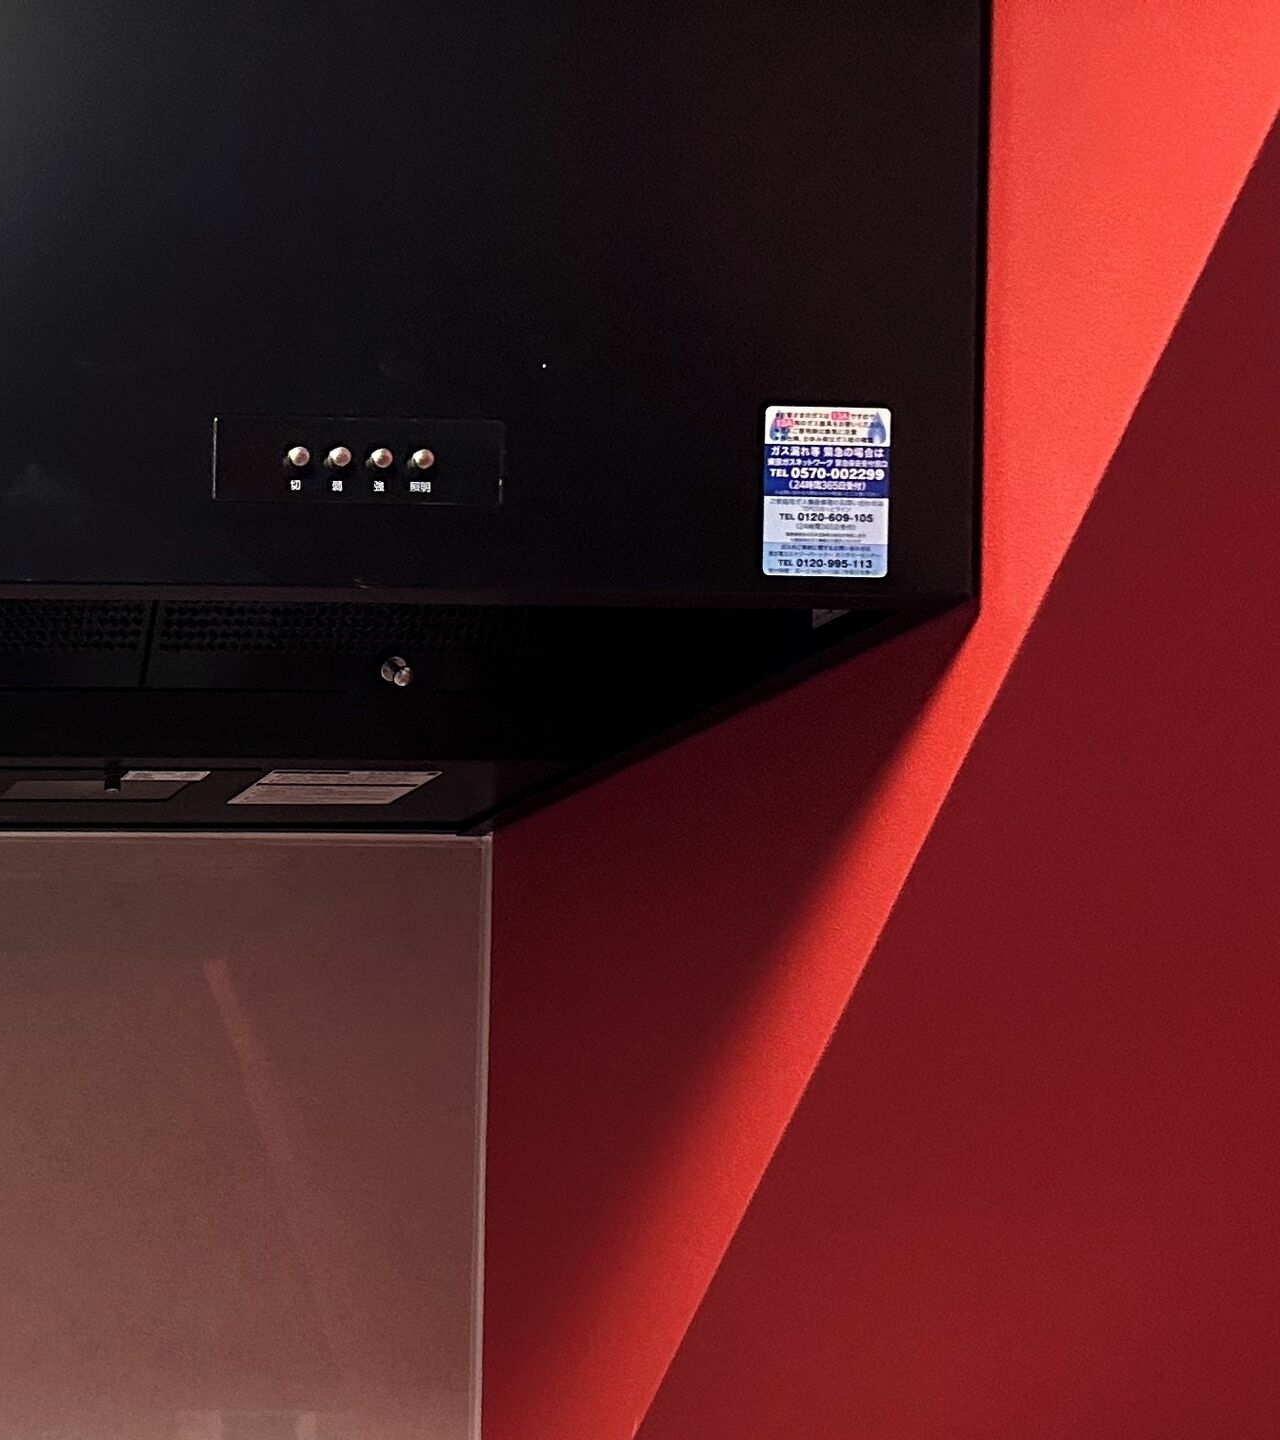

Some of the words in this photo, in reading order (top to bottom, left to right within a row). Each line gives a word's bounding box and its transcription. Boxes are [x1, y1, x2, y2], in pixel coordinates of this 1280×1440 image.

[769, 468, 789, 477] TEL
[790, 467, 885, 480] 0570-002299
[779, 513, 795, 521] TEL
[797, 512, 874, 523] 0120-609-105
[778, 559, 794, 567] TEL
